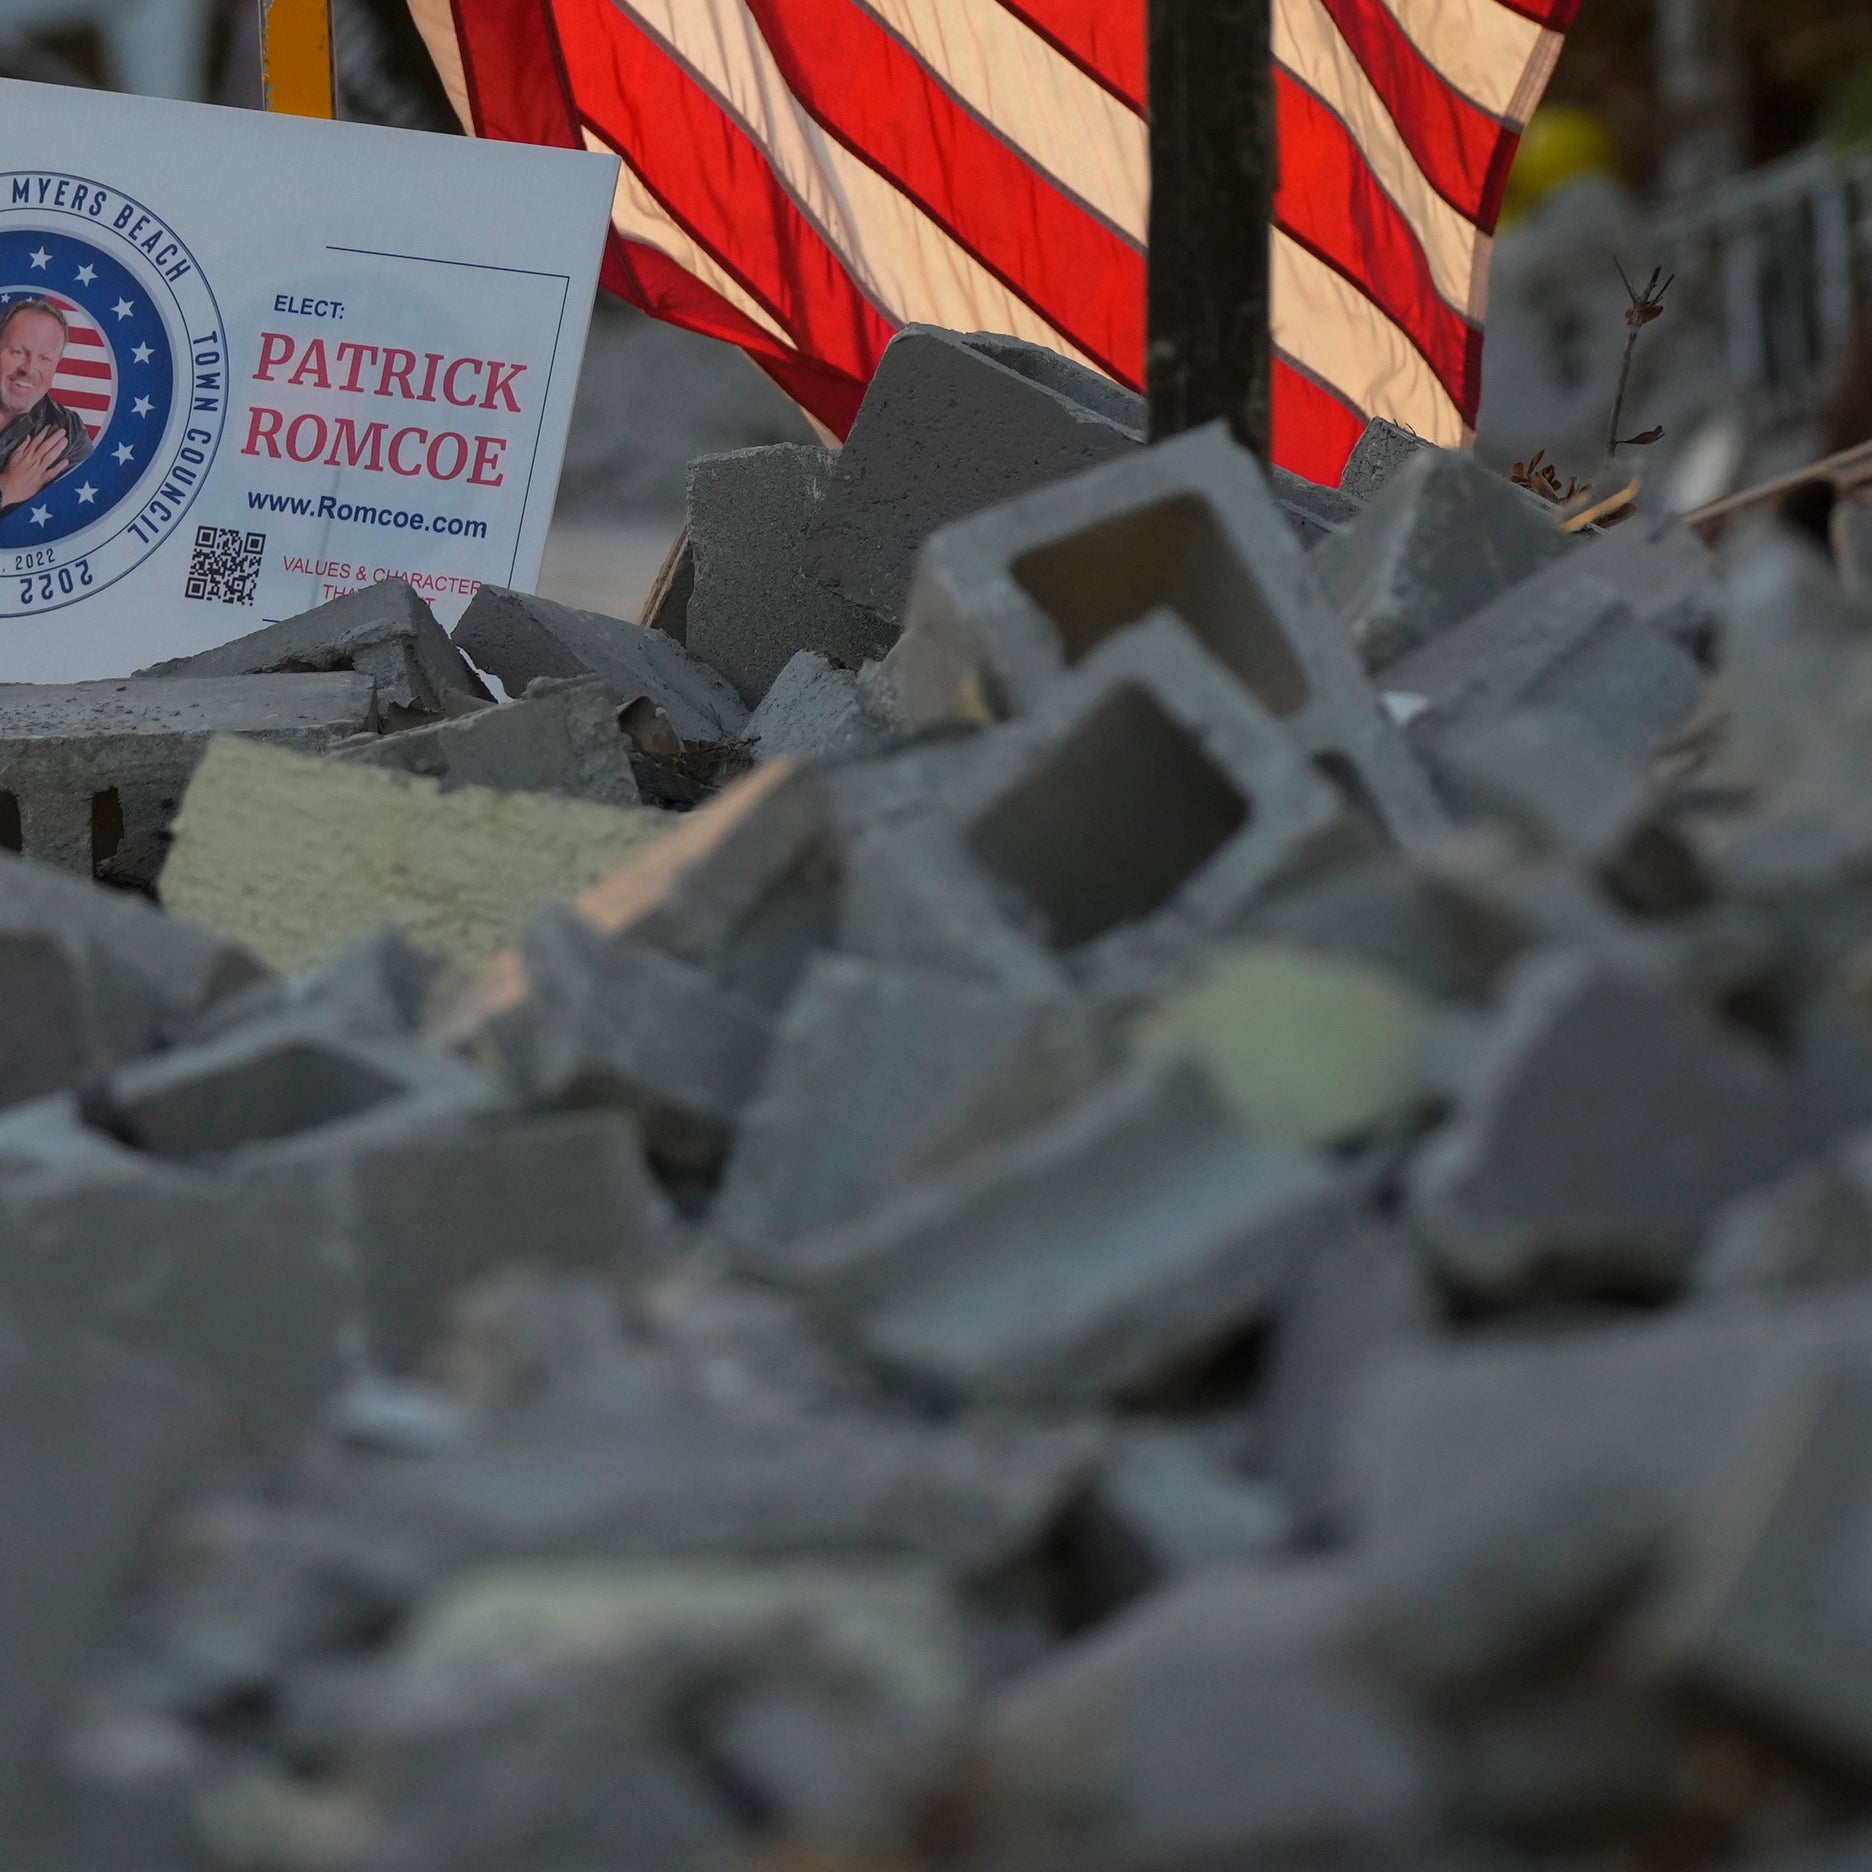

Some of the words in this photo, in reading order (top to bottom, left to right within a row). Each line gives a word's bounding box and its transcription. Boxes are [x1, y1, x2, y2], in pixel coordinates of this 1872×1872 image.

[12, 177, 108, 215] MYERS
[113, 204, 191, 283] BEACH
[274, 295, 345, 319] ELECT:
[193, 331, 221, 412] TOWN
[253, 332, 527, 413] PATRICK
[241, 407, 507, 486] ROMCOE
[127, 430, 212, 544] COUNCIL
[247, 491, 487, 539] www.Romcoe.com
[16, 548, 56, 569] 2022
[20, 560, 94, 604] 2022
[283, 556, 350, 578] VALUES
[356, 566, 367, 581] &
